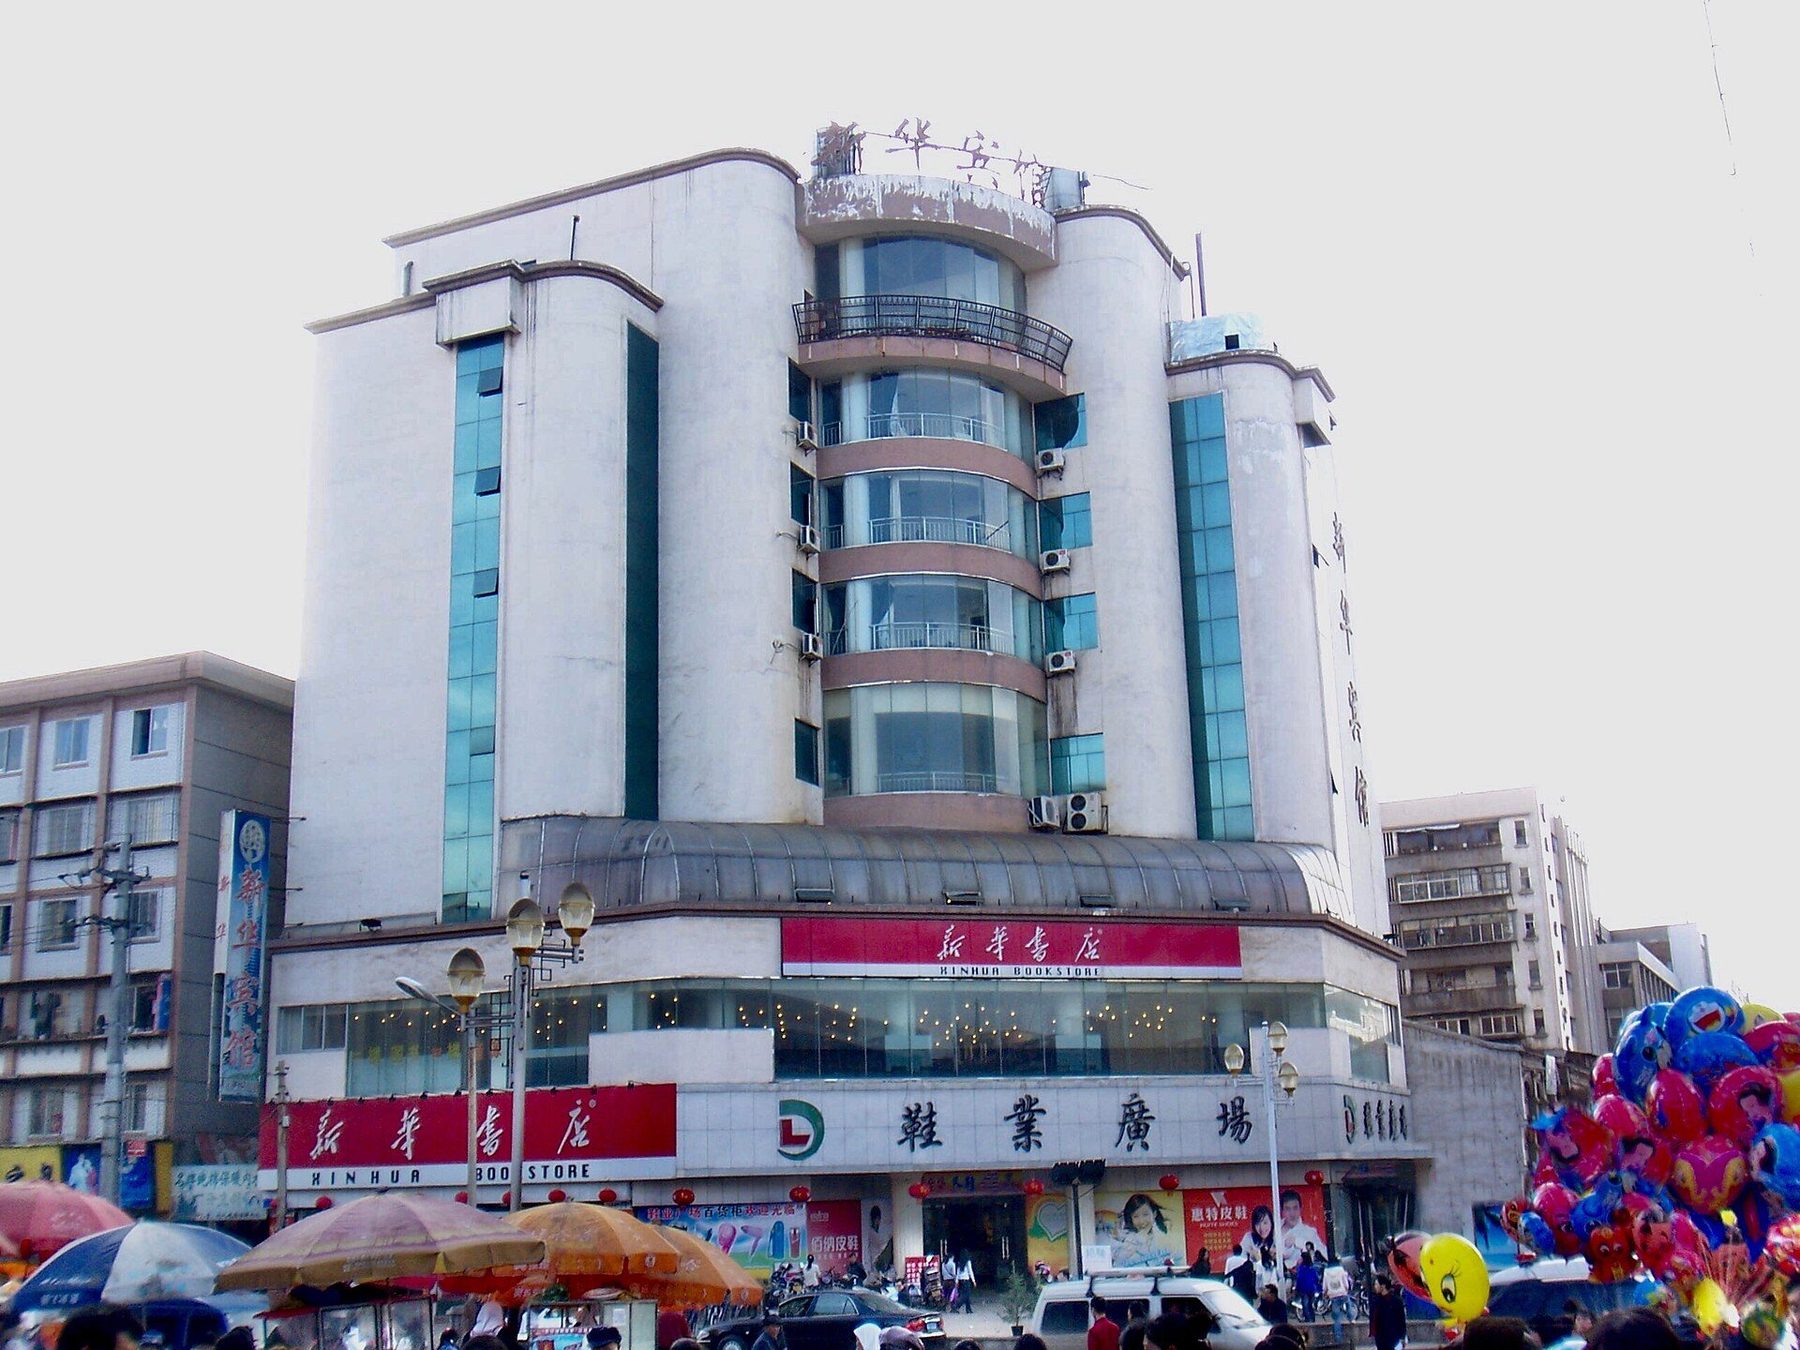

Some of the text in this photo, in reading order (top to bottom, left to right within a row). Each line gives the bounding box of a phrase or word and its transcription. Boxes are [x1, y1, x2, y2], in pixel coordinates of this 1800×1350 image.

[939, 966, 1101, 977] XINHUA BOOKSTORE
[312, 1163, 590, 1186] XINHUA BOOSTORE
[1191, 1205, 1248, 1222] 惠特皮鞋
